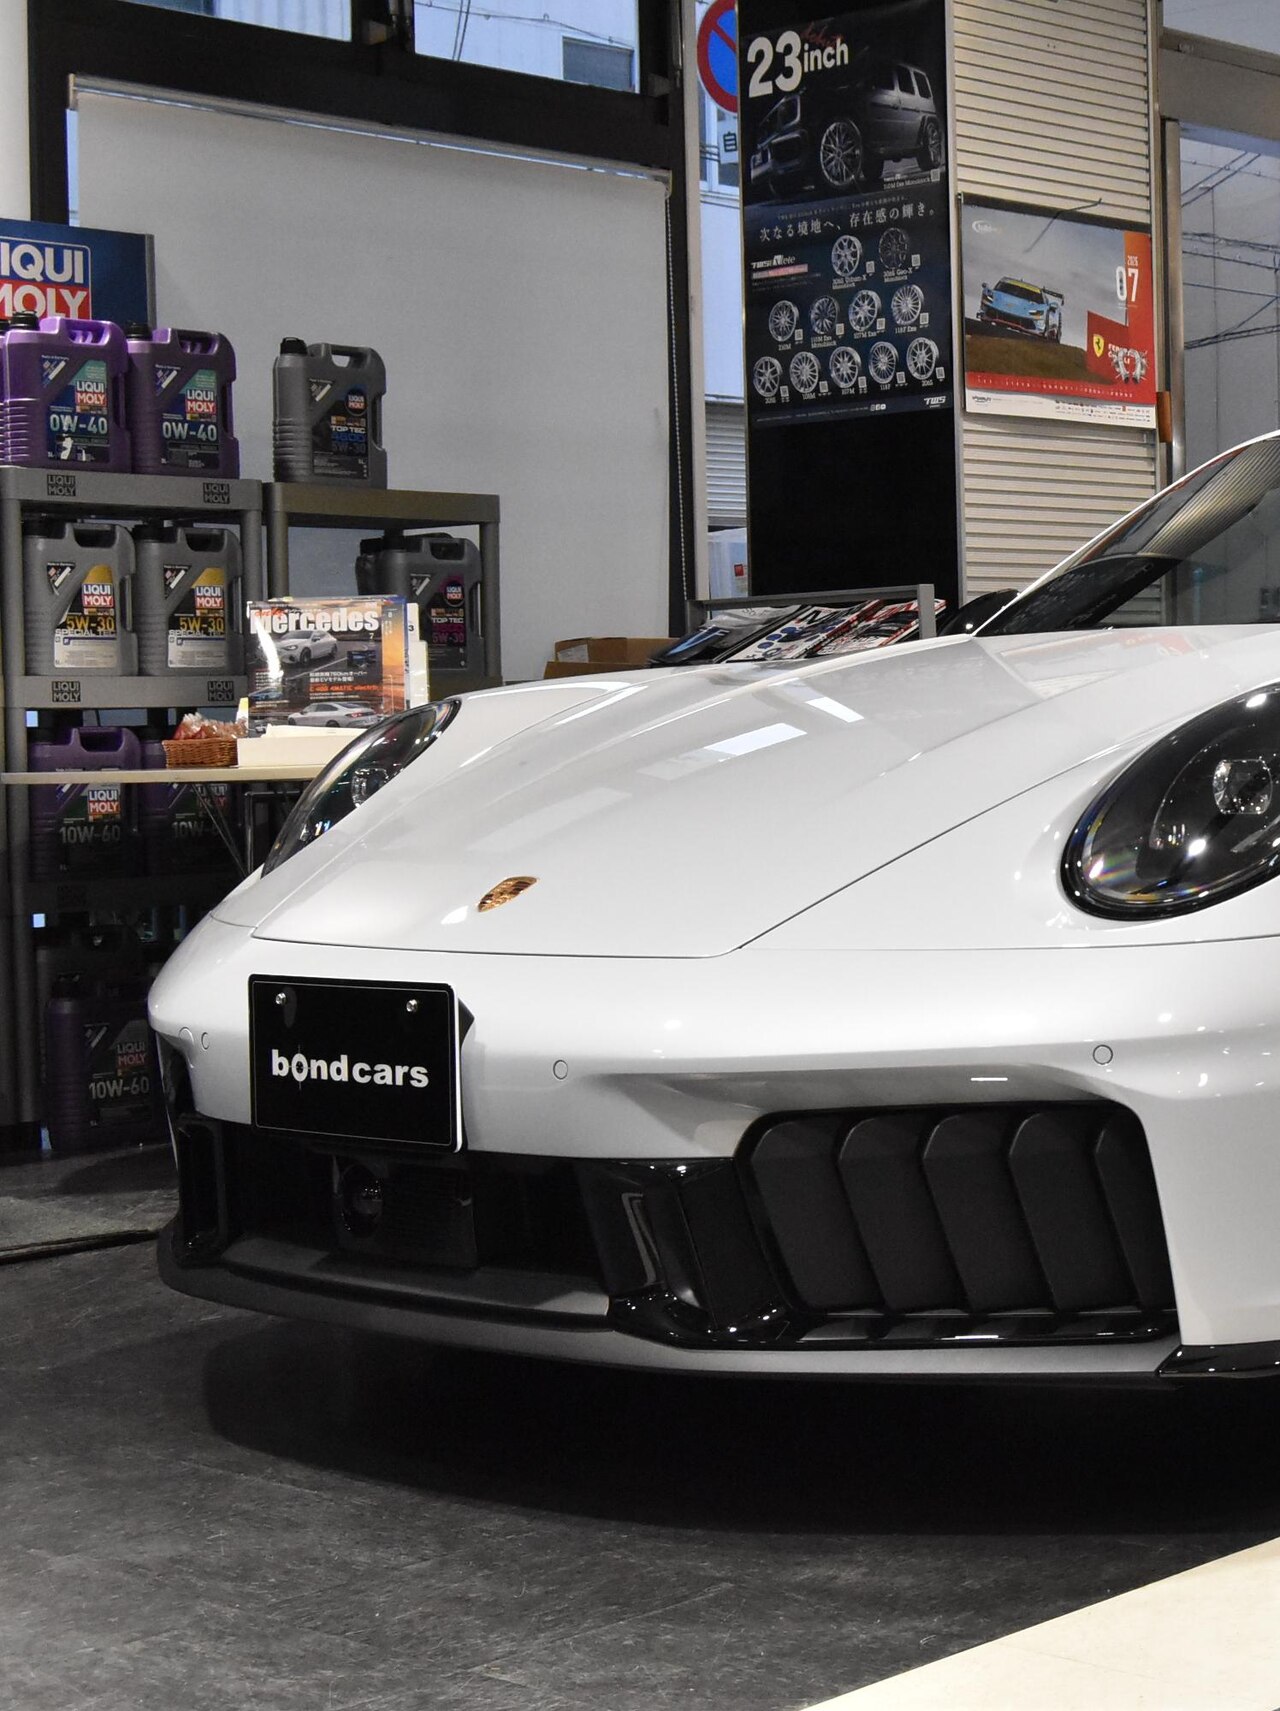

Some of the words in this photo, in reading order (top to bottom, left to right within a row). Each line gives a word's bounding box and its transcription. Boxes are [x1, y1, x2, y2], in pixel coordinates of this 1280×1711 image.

[747, 30, 802, 98] 23
[804, 37, 849, 73] inch
[0, 242, 84, 283] IQUI
[1116, 266, 1139, 302] 07
[76, 381, 105, 393] LIQUI
[77, 392, 106, 405] MOLY
[187, 390, 214, 401] LIQUI
[924, 396, 946, 405] TWS
[187, 401, 215, 413] MOLY
[50, 414, 108, 434] 0W-40
[162, 422, 217, 440] 0W-40
[48, 475, 75, 486] LIQUI
[48, 486, 76, 496] MOLY
[204, 483, 229, 494] LIQUI
[204, 493, 230, 504] MOLY
[83, 584, 111, 595] LIQUI
[196, 586, 222, 597] LIQUI
[84, 595, 113, 606] MOLY
[196, 597, 223, 608] MOLY
[66, 616, 114, 632] 5W-30
[180, 618, 224, 633] 5W-30
[55, 628, 94, 637] SPECIAL
[53, 682, 79, 692] LIQUI
[208, 682, 233, 692] LIQUI
[53, 691, 80, 702] MOLY
[208, 691, 234, 701] MOLY
[89, 790, 118, 801] LIQUI
[90, 802, 119, 813] MOLY
[60, 825, 121, 843] 10W-60
[117, 1042, 145, 1054] LIQUI
[118, 1053, 146, 1065] MOLY
[89, 1076, 150, 1099] 10W-60
